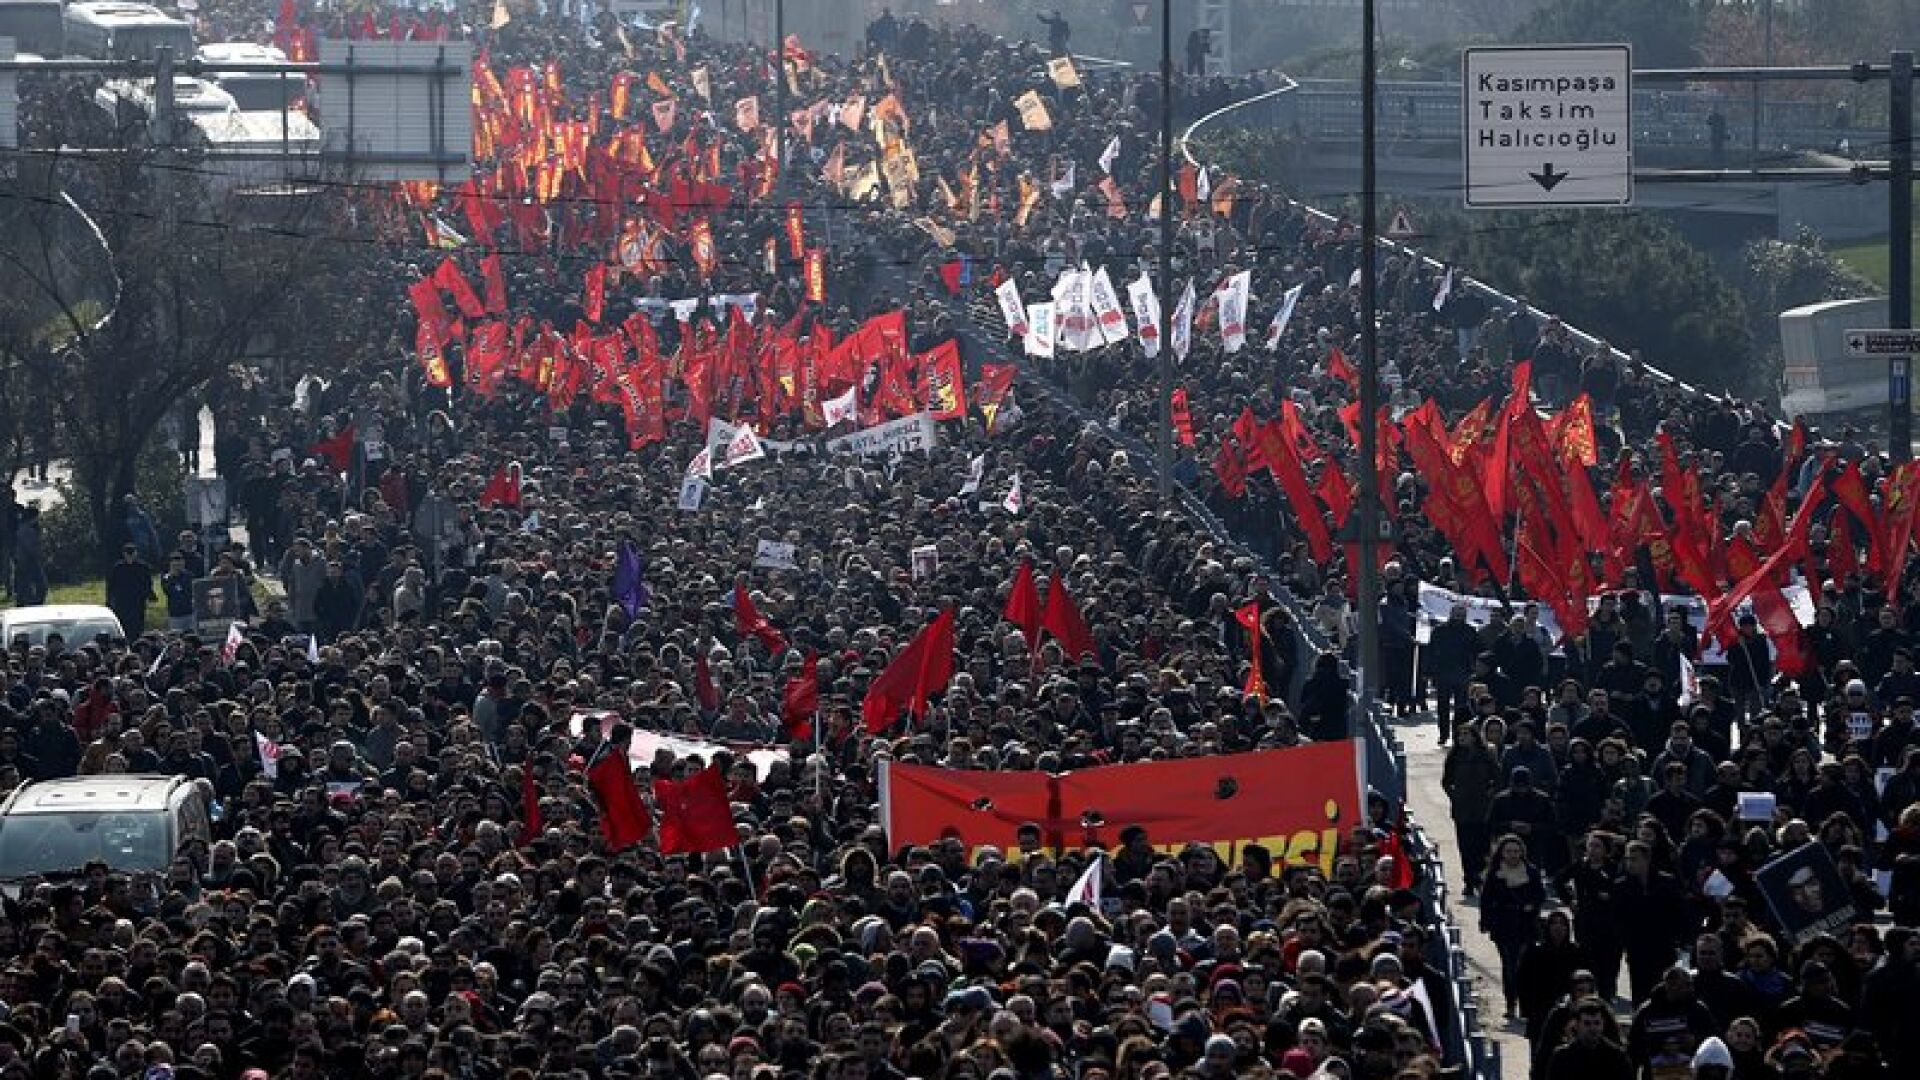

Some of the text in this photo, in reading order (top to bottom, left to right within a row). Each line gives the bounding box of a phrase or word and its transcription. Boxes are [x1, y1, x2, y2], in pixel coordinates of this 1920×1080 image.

[1478, 73, 1616, 96] Kasımpaşa
[1479, 100, 1594, 120] Taksim
[1479, 127, 1616, 151] Halıcıoğlu
